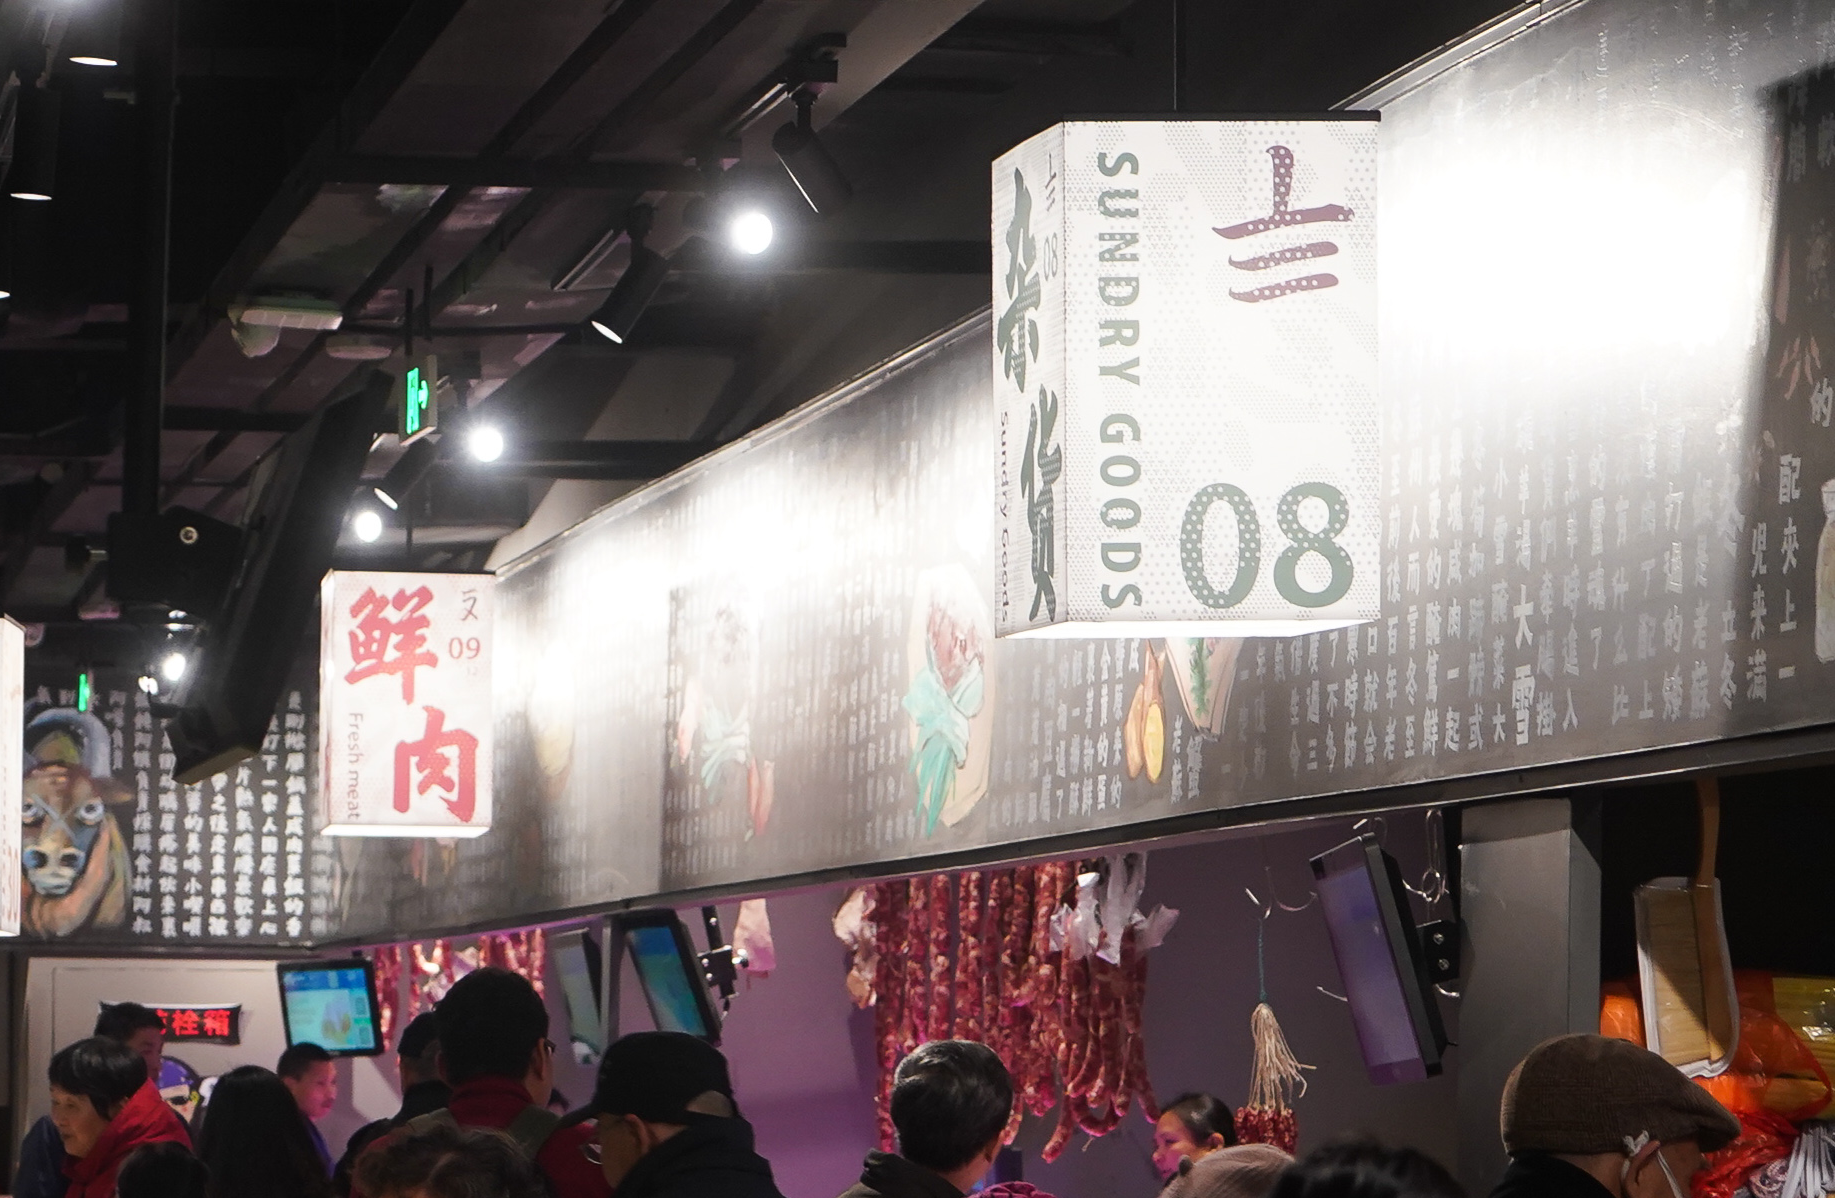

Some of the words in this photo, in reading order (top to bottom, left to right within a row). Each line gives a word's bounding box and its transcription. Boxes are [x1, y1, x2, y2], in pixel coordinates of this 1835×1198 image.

[1043, 231, 1059, 282] 08
[1097, 151, 1141, 387] SUNDRY
[1000, 411, 1009, 519] Sundry
[1098, 413, 1143, 610] GOODS
[1001, 528, 1010, 622] Goods
[1179, 481, 1355, 610] 08
[449, 636, 481, 659] 09
[1511, 583, 1535, 745] 大雪
[347, 712, 364, 767] Fresh
[347, 770, 362, 821] meat
